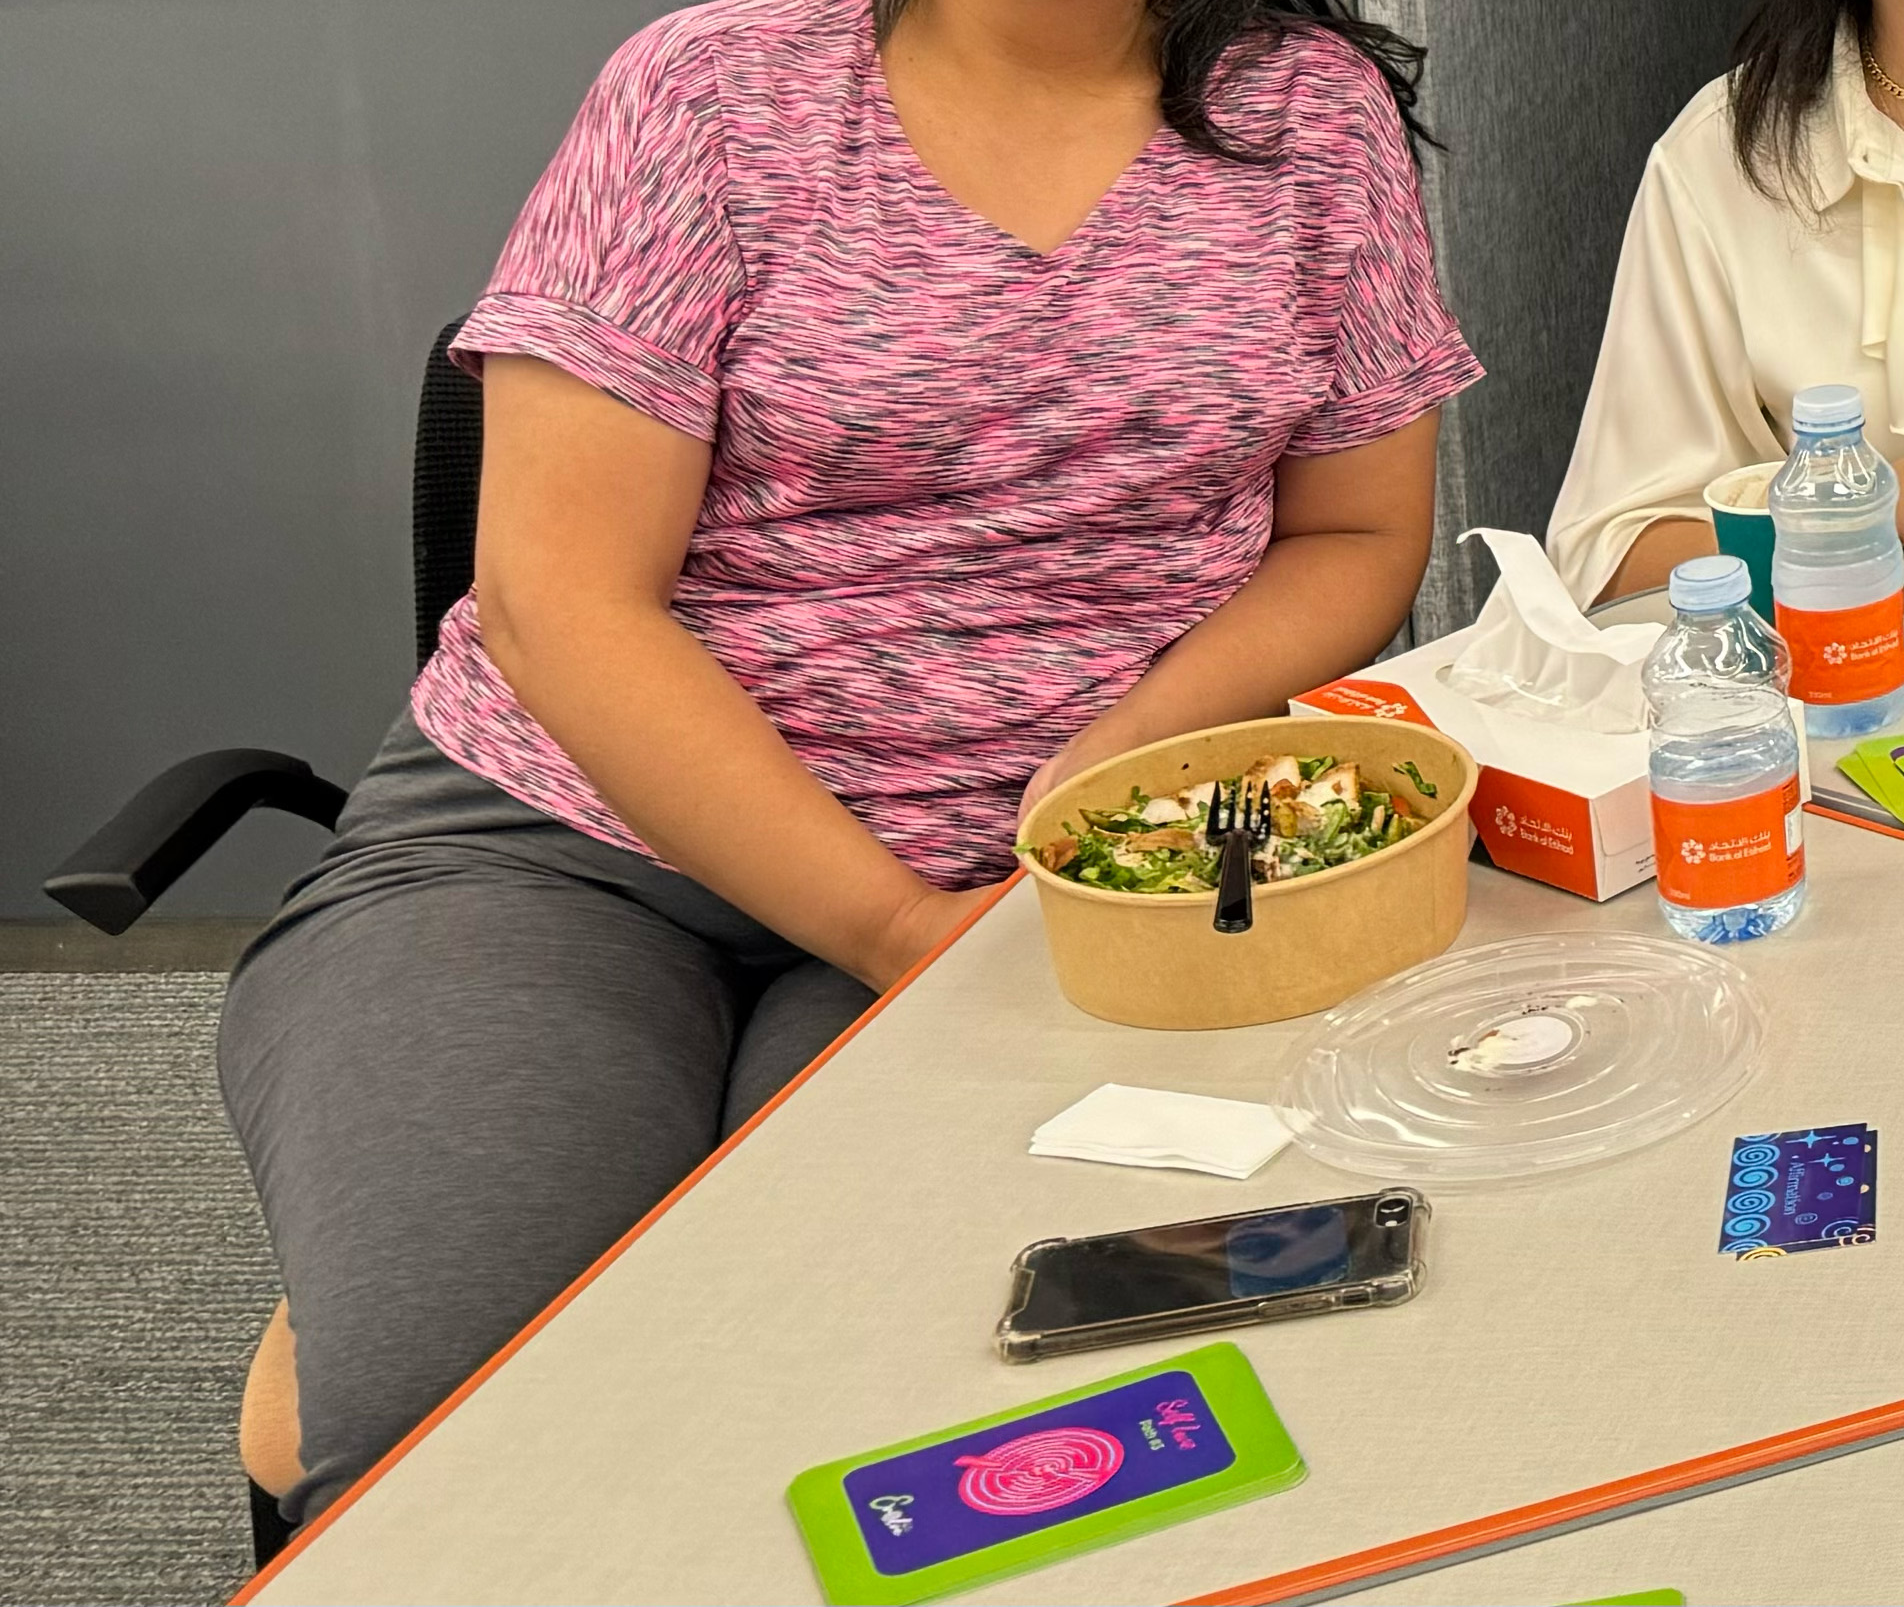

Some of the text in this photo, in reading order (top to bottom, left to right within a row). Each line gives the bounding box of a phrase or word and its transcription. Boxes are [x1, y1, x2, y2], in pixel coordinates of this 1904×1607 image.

[1709, 850, 1732, 862] Bank
[1744, 842, 1772, 858] Etihad
[1784, 1162, 1804, 1215] Affirmation
